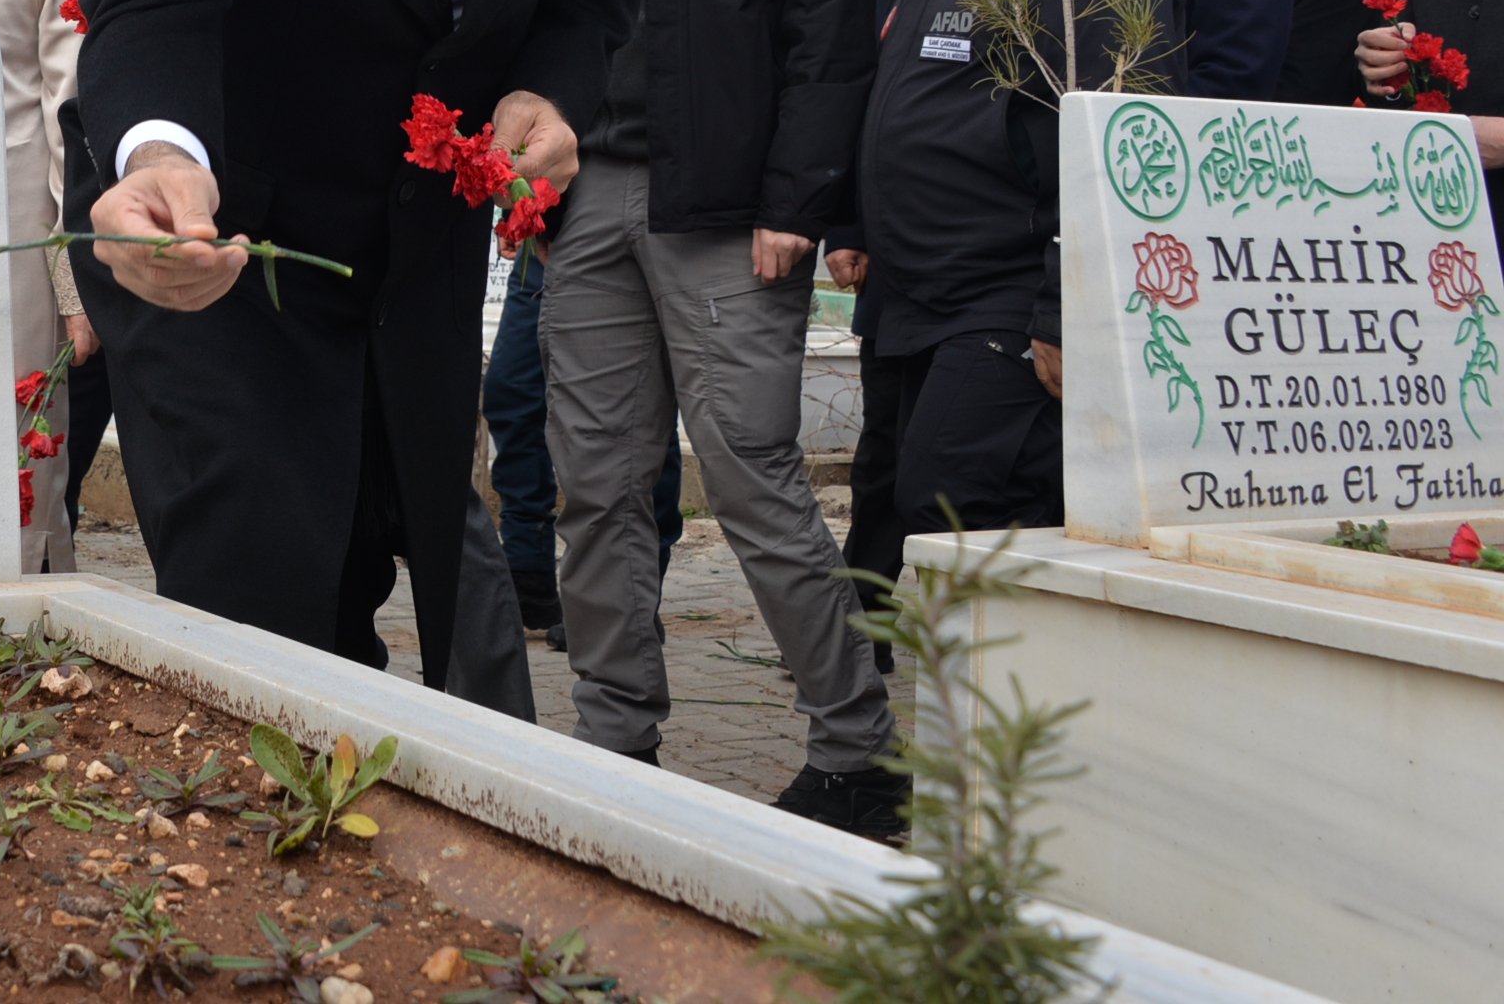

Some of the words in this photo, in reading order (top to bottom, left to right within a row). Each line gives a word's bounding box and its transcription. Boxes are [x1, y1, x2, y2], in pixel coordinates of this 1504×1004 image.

[929, 11, 973, 32] AFAD
[1207, 225, 1418, 285] MAHİR
[1224, 293, 1424, 366] GÜLEÇ
[1215, 374, 1447, 409] D.T.20.01.1980
[1221, 418, 1454, 456] V.T.06.02.2023
[1181, 469, 1329, 513] Ruhuna
[1343, 465, 1379, 504] El
[1395, 462, 1504, 511] Fatiha
